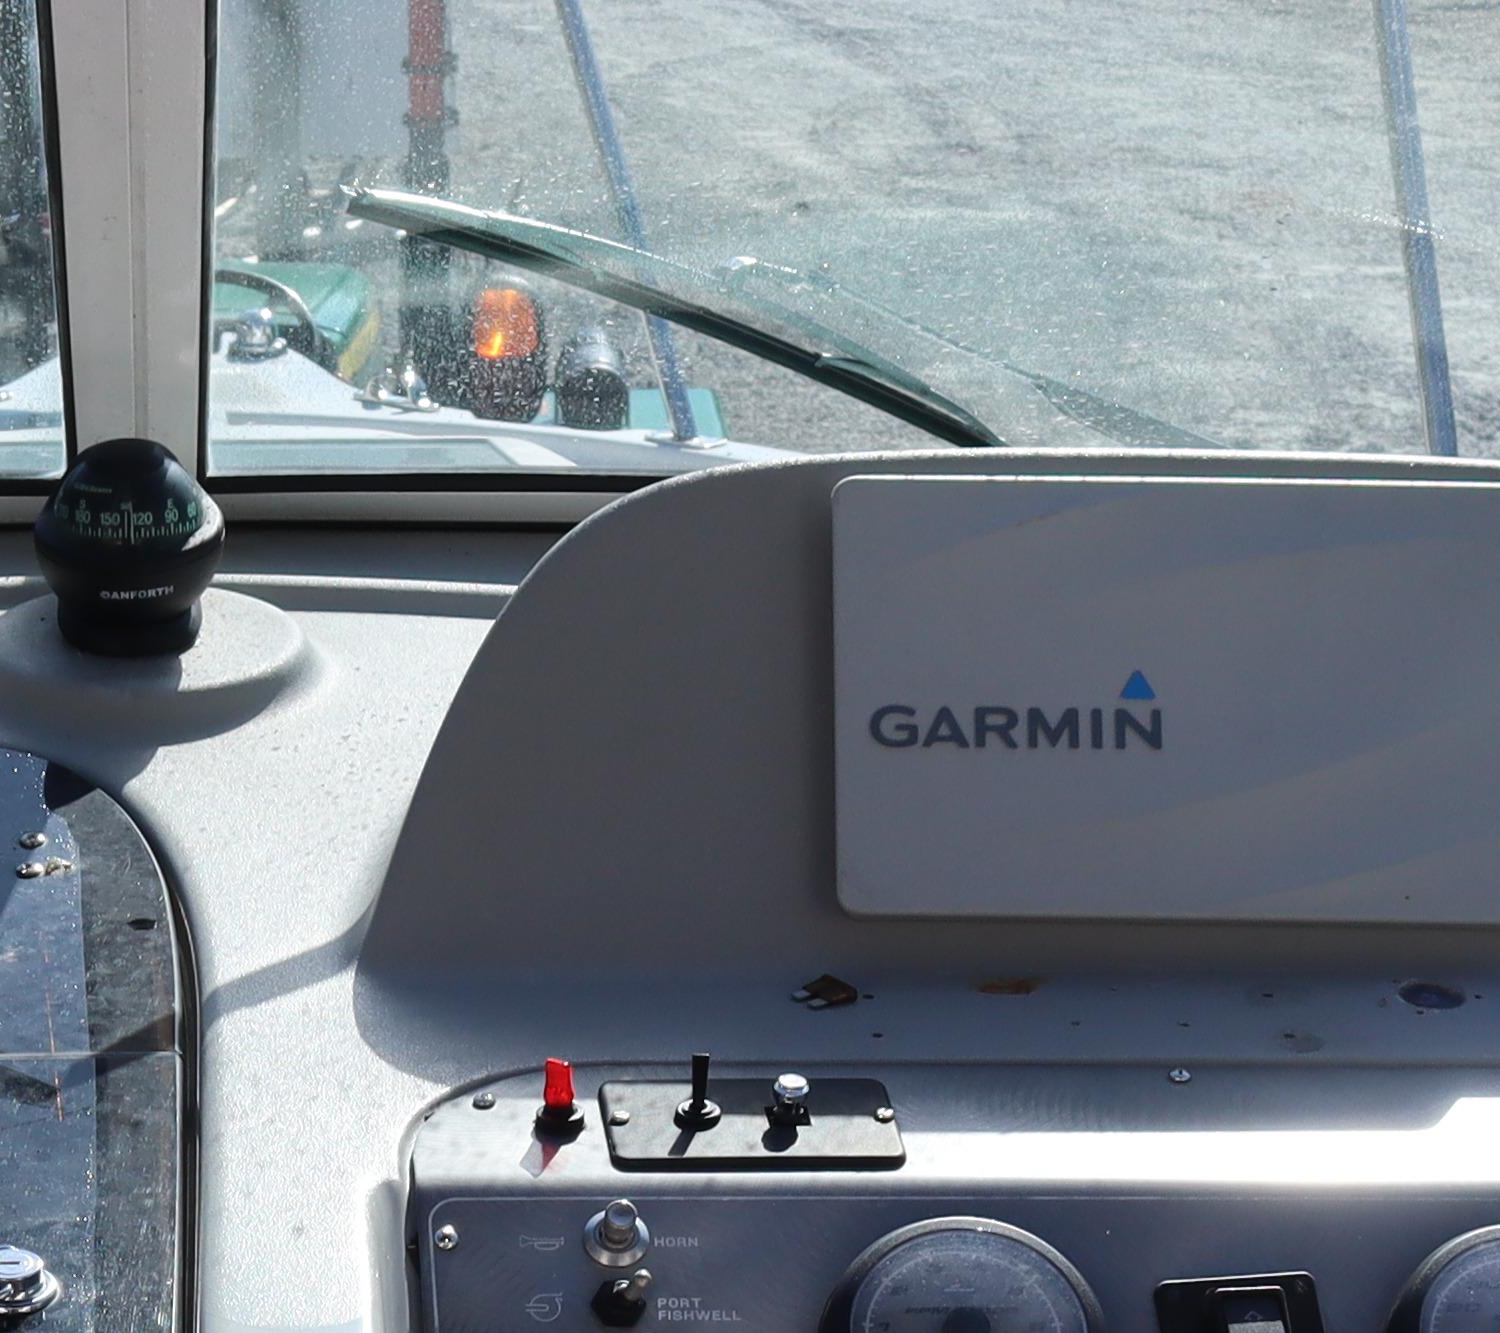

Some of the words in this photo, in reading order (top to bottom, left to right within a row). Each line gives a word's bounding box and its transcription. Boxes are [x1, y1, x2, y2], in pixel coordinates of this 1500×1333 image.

[100, 586, 174, 599] DANFORTH
[869, 704, 1162, 750] GARMIN
[654, 1236, 699, 1248] HORN
[657, 1298, 702, 1309] PORT
[657, 1310, 742, 1321] FISHWELL
